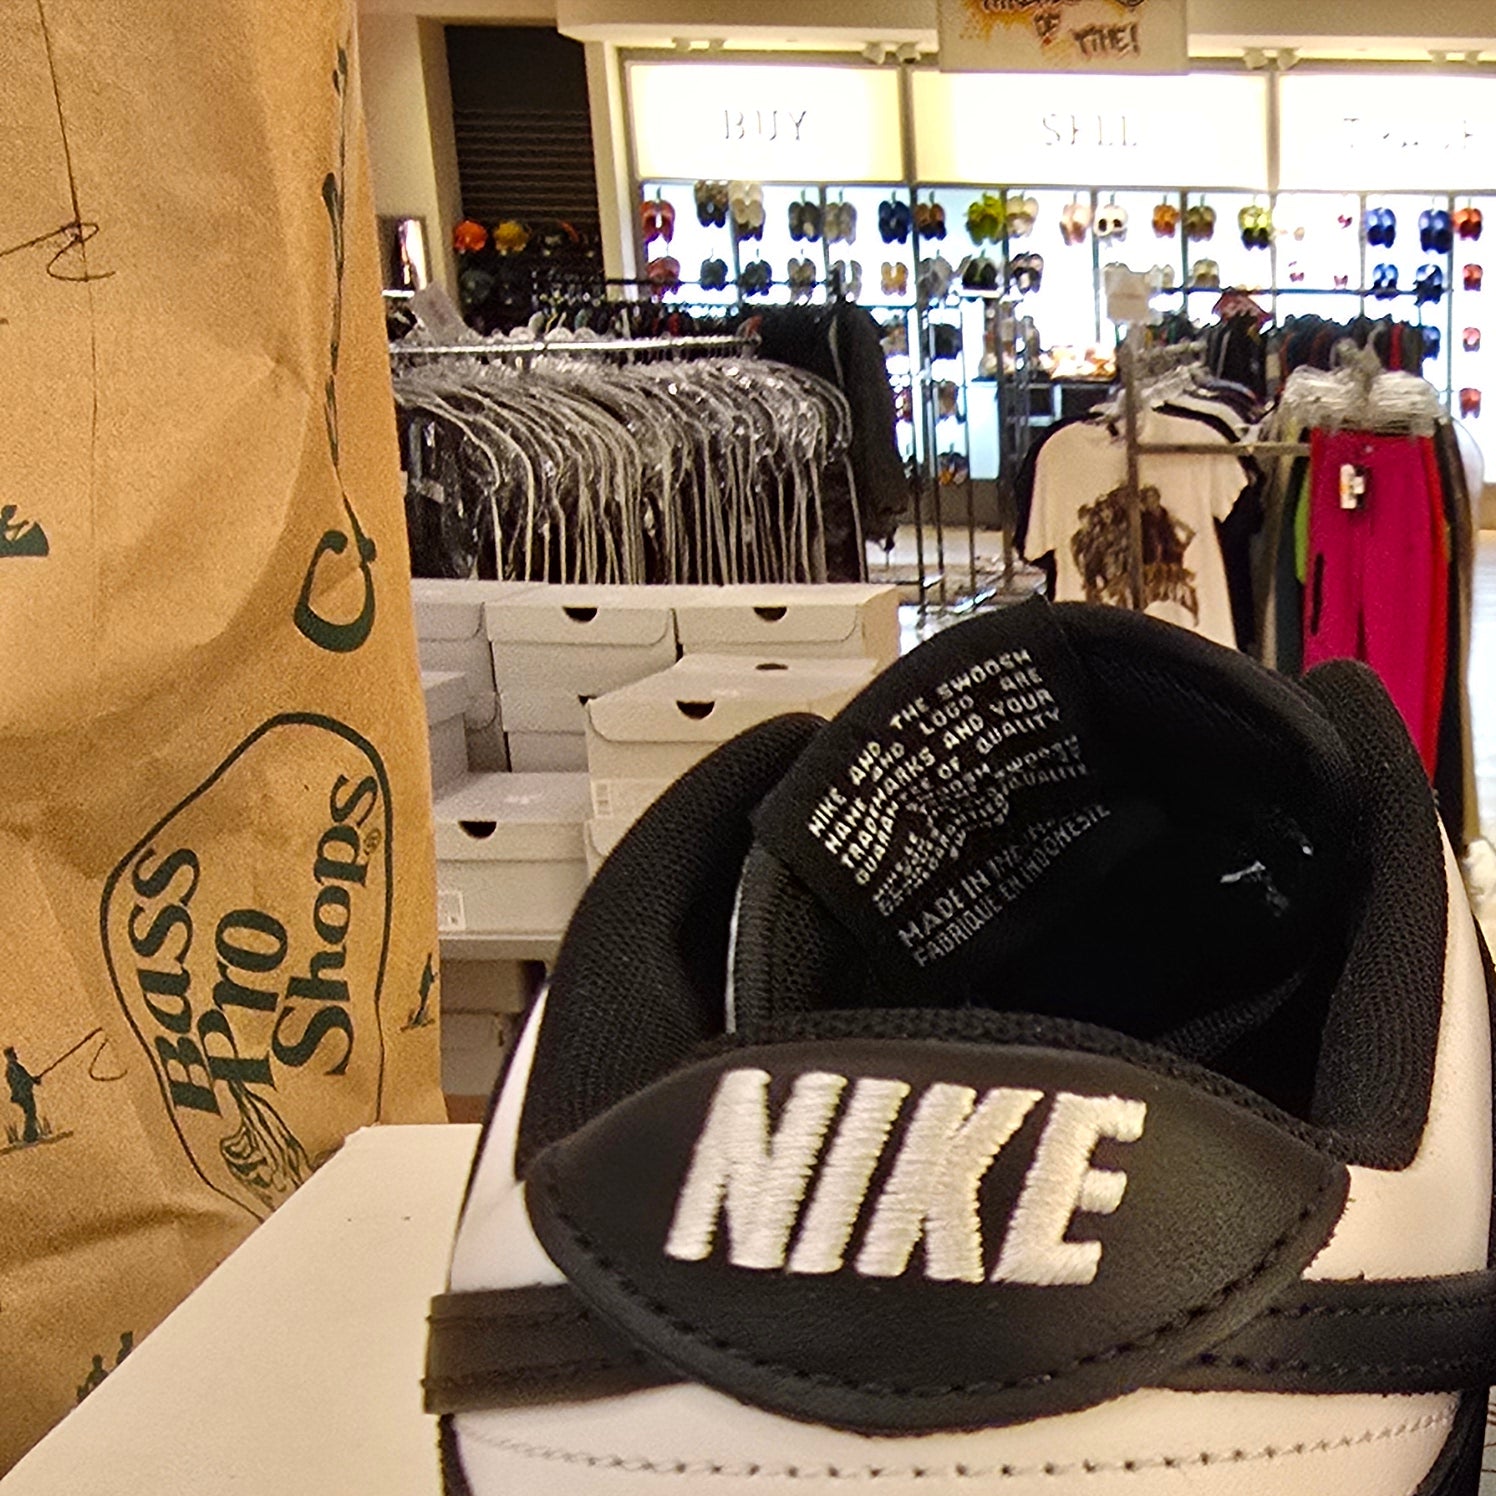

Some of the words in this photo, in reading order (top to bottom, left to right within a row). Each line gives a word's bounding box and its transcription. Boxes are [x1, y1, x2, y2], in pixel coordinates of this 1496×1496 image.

[724, 109, 807, 141] BUY
[807, 786, 847, 838] NIKE
[849, 741, 881, 786] AND
[889, 697, 930, 730] THE
[936, 648, 1032, 700] SWOOSH
[824, 797, 868, 855] NAME
[871, 741, 905, 783] AND
[919, 693, 975, 736] LOGO
[999, 666, 1044, 692] ARE
[937, 755, 960, 780] OF
[976, 705, 1060, 755] QUALITY
[942, 713, 984, 750] AND
[989, 688, 1056, 718] YOUR
[128, 848, 222, 1117] Bass
[196, 908, 289, 1092] Pro
[271, 774, 379, 1077] Shops
[898, 888, 965, 948] MADE
[961, 868, 991, 900] IN
[665, 1068, 1147, 1286] NIKE
